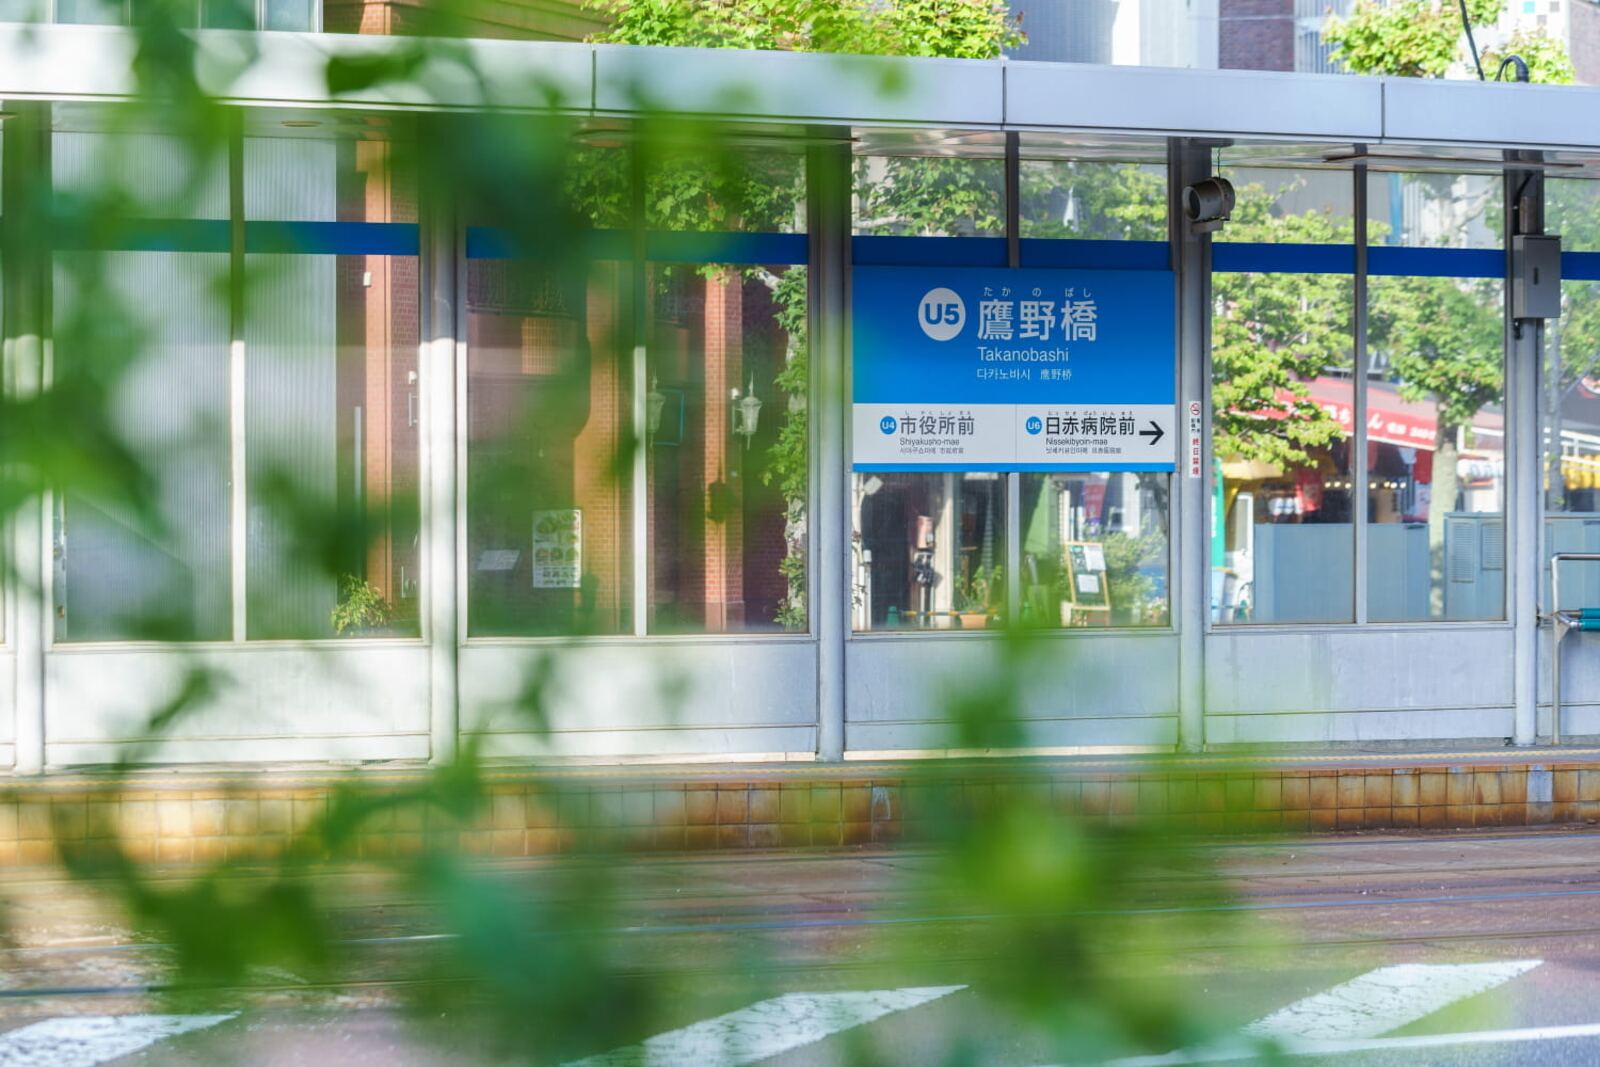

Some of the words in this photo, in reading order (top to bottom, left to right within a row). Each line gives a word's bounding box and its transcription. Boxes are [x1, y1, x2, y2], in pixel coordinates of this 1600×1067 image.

[925, 303, 959, 325] U5
[977, 299, 1097, 341] 鷹野橋
[977, 347, 1069, 362] Takanobashi
[882, 421, 895, 429] U4
[900, 416, 975, 435] 市役所前
[1027, 421, 1041, 430] U6
[1046, 416, 1135, 435] 日赤病院前
[899, 437, 960, 446] Shiyakusho-mae
[1046, 438, 1108, 446] Nissekibyoin-mae
